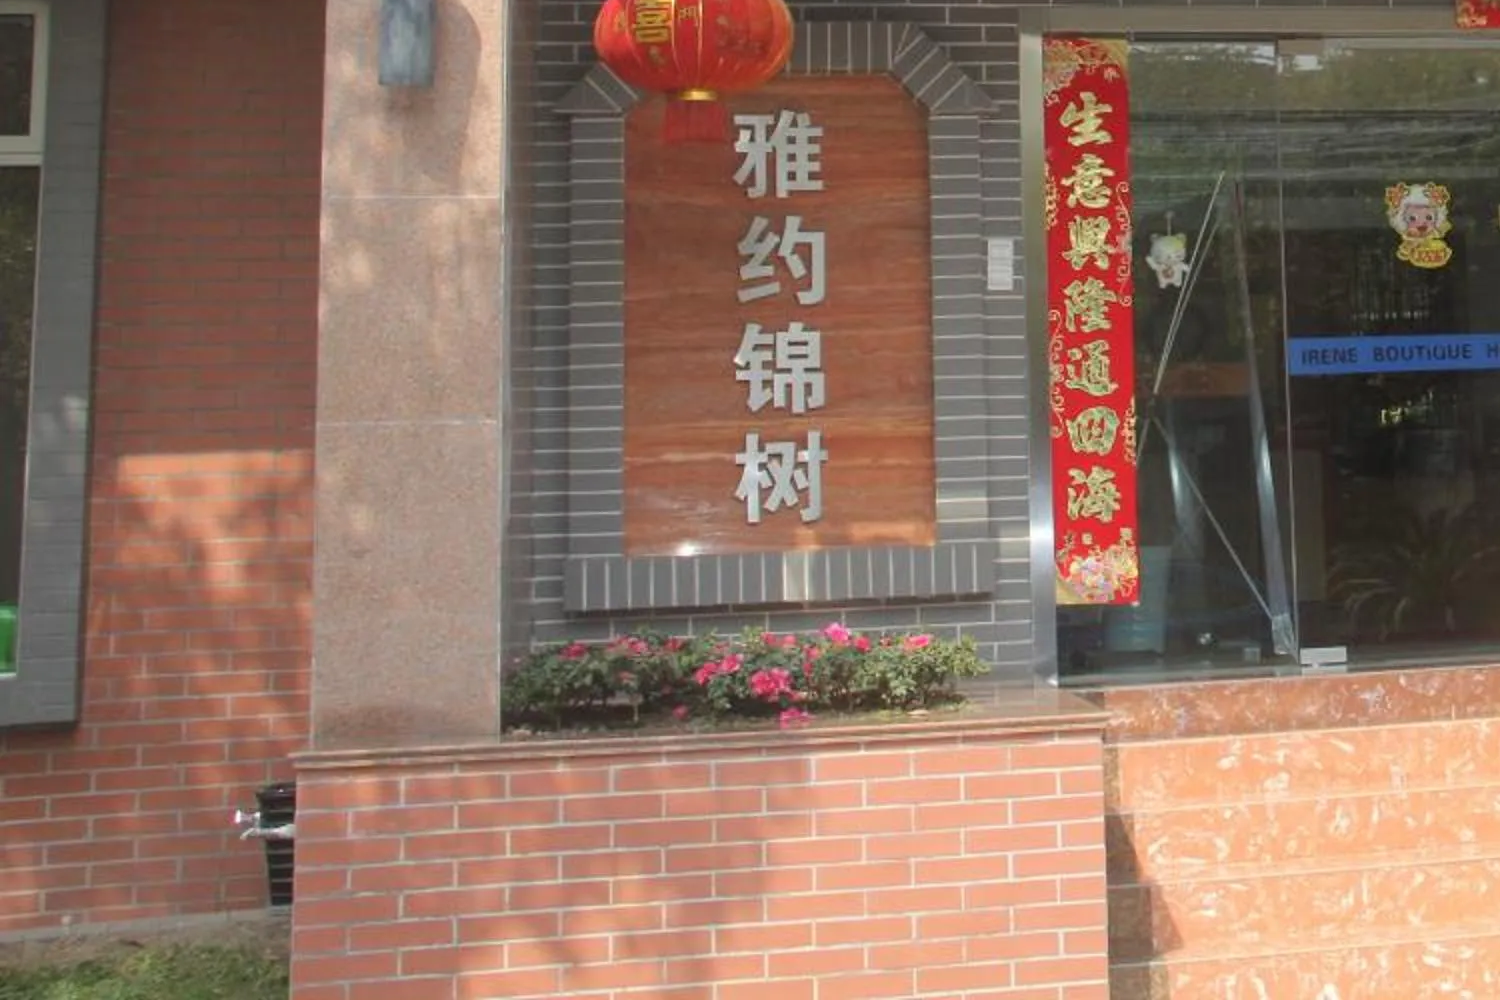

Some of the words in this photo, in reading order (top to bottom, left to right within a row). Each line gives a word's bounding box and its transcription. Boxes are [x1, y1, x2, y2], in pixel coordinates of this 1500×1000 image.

[732, 109, 829, 525] 雅约锦树
[1301, 347, 1359, 366] IRENE
[1373, 343, 1474, 363] BOUTIQUE
